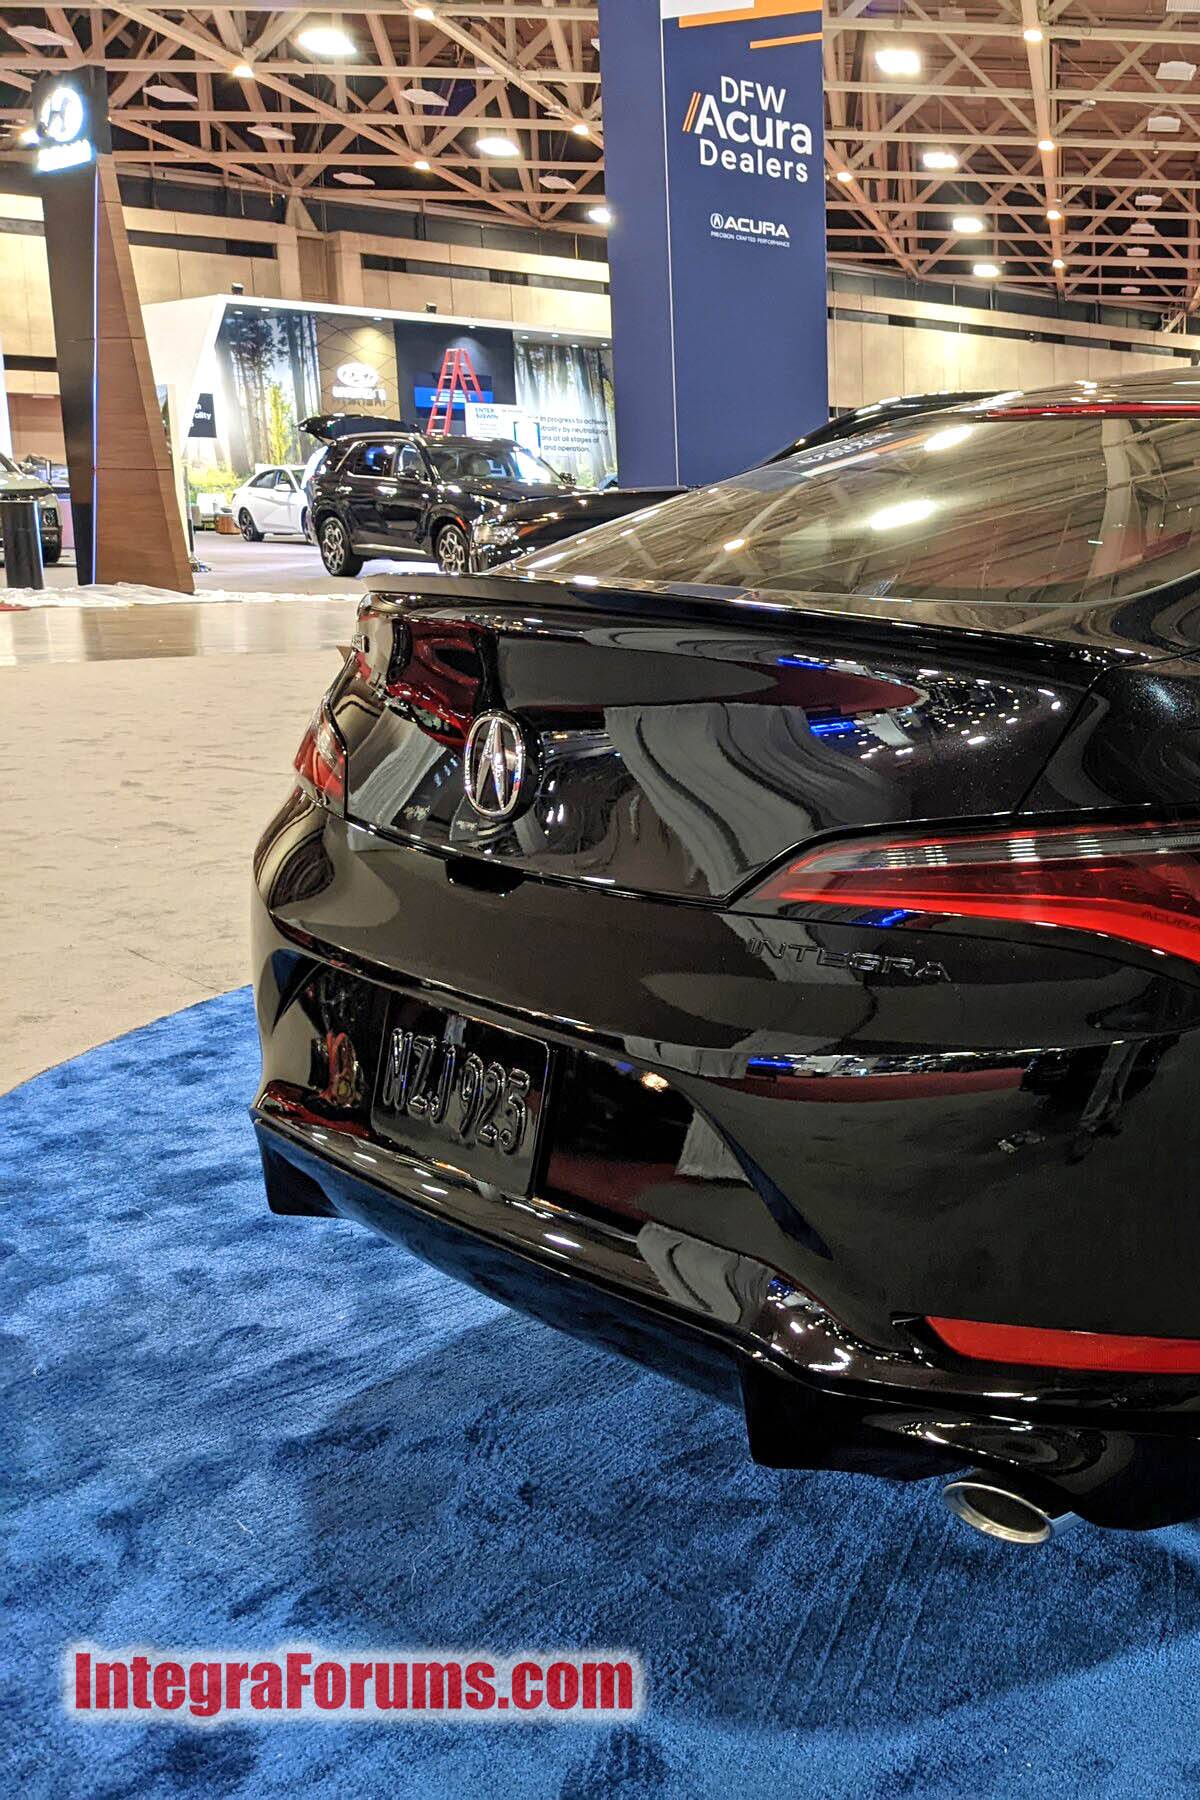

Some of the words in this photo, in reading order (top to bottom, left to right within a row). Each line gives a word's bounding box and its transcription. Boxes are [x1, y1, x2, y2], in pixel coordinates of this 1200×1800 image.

[721, 75, 786, 114] DFW
[694, 94, 812, 155] Acura
[699, 139, 809, 183] Dealers
[724, 216, 790, 238] ACURA
[750, 938, 951, 982] INTEGRA
